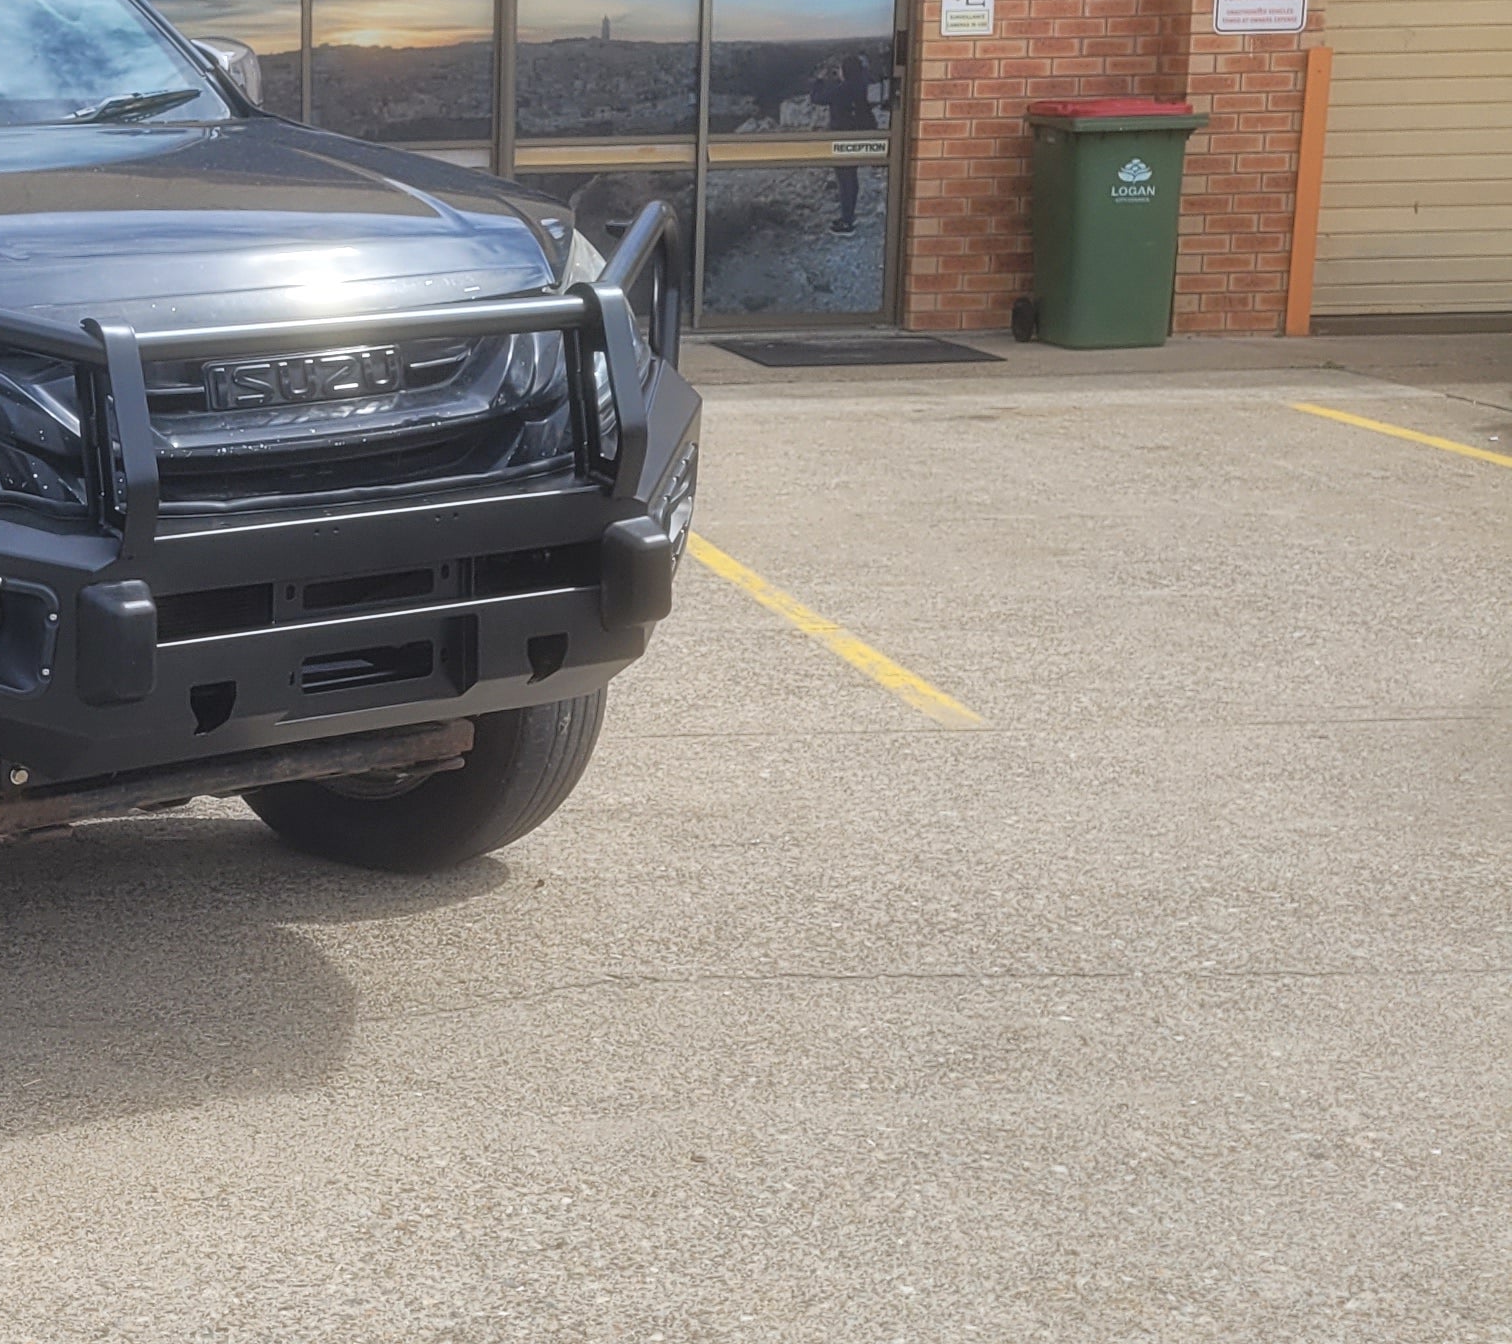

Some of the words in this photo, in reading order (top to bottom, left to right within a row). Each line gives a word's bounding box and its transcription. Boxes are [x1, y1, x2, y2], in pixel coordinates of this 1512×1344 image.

[833, 142, 886, 153] RECEPTION
[1110, 185, 1156, 197] LOGAN
[209, 350, 400, 409] ISUZU
